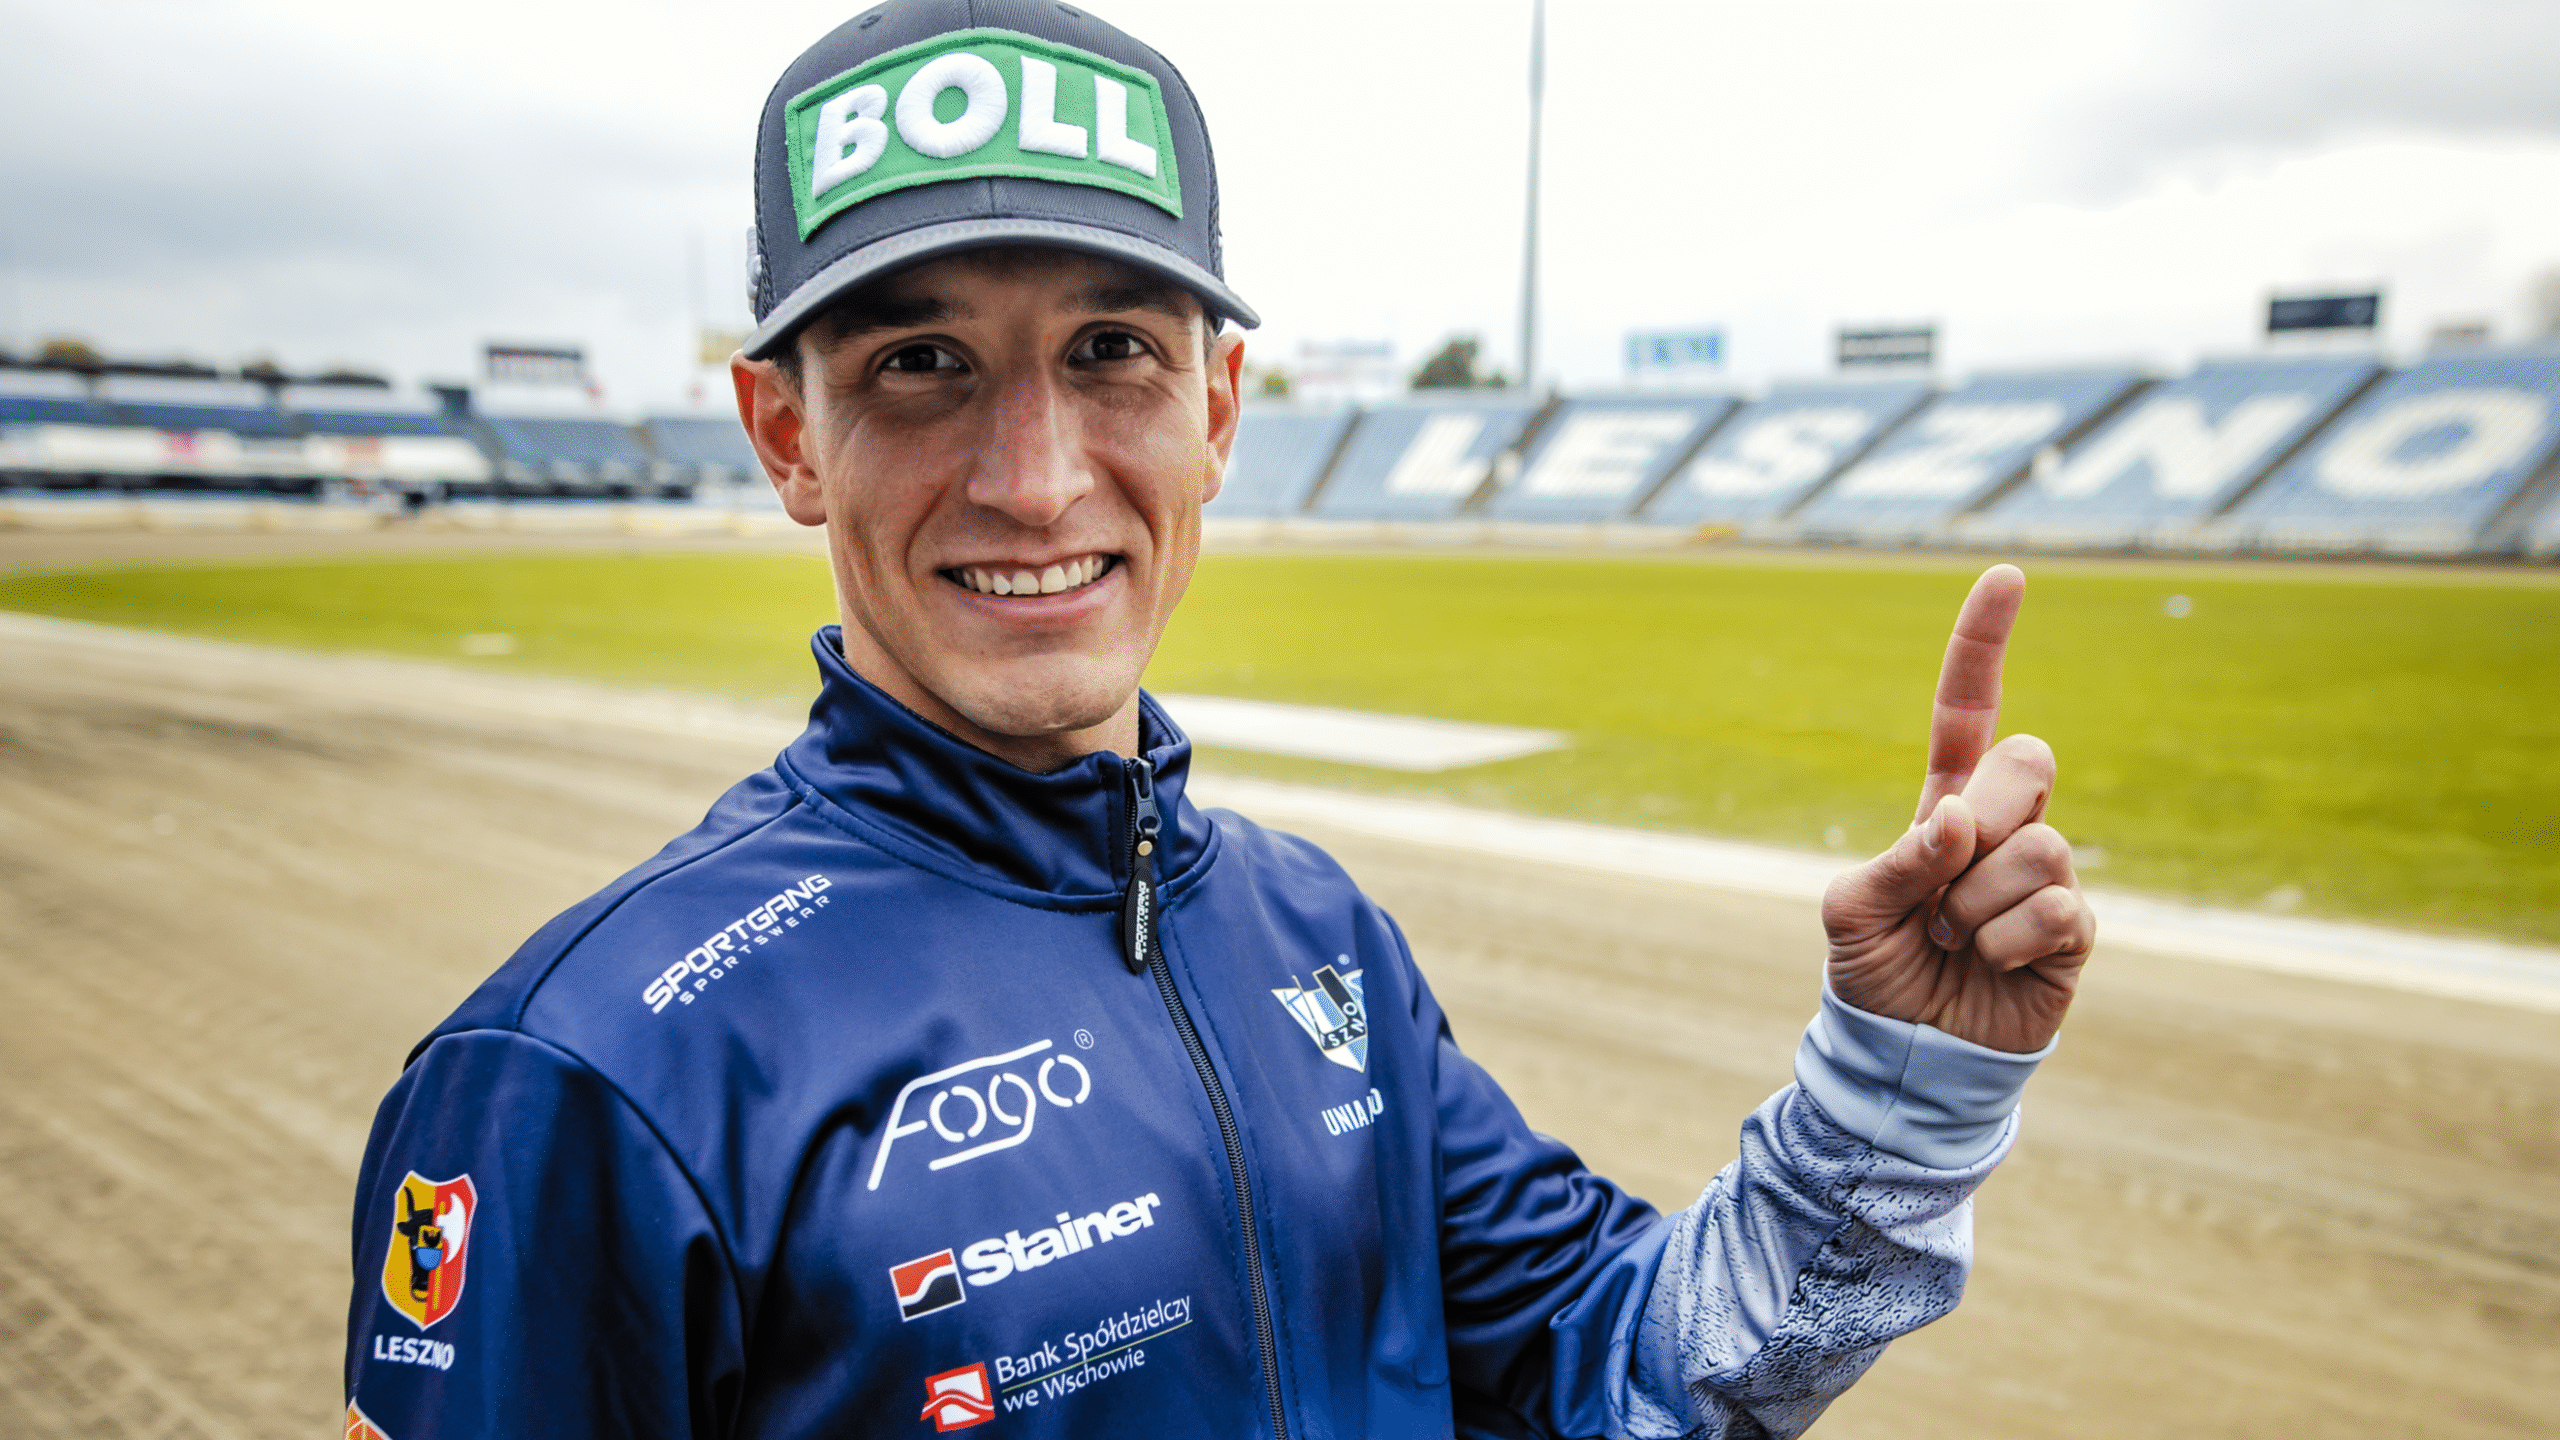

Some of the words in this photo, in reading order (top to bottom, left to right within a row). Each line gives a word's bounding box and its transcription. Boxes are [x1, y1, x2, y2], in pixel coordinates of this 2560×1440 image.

[811, 51, 1157, 200] BOLL
[1383, 388, 2548, 502] LESZNO
[642, 873, 833, 1014] SPORTGANG
[679, 895, 831, 1006] SPORTSWEAR
[1321, 1099, 1370, 1137] UNIA
[960, 1192, 1161, 1287] Stainer
[373, 1334, 455, 1371] LESZNO
[995, 1340, 1061, 1385] Bank
[1064, 1295, 1191, 1362] Spółdzielczy
[1002, 1388, 1040, 1414] we
[1042, 1347, 1146, 1400] Wschowie
